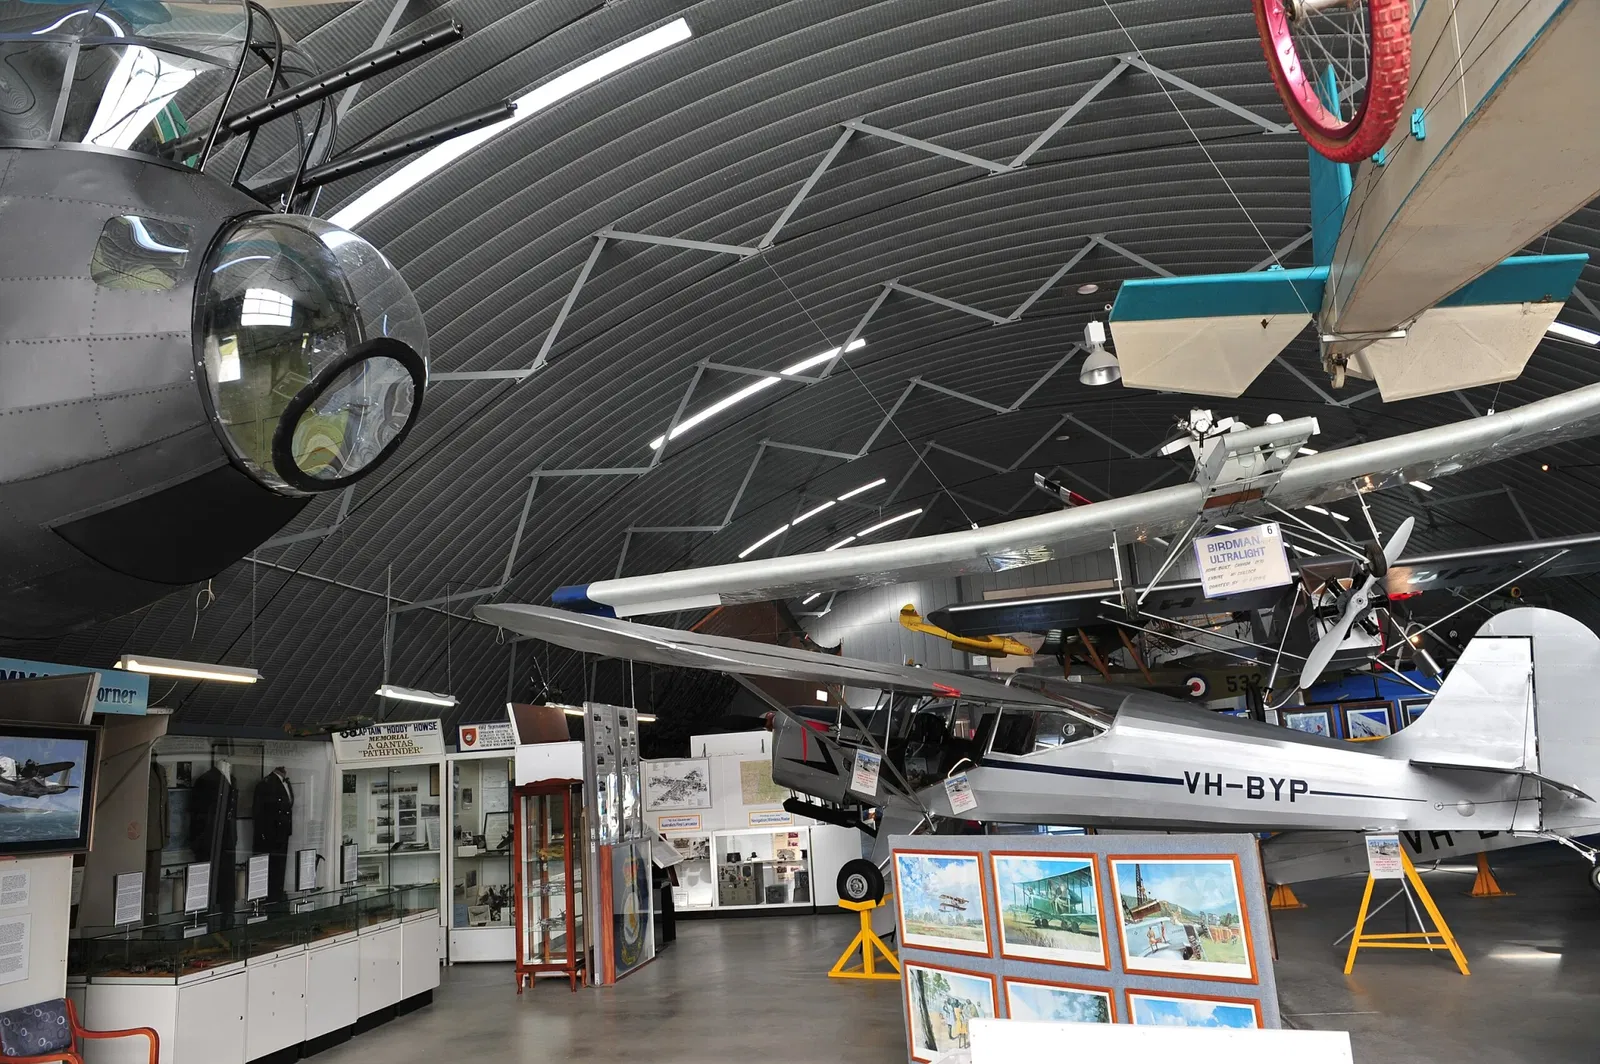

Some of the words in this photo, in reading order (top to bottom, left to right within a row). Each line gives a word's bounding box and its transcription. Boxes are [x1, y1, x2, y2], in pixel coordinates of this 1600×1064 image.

[1266, 525, 1273, 535] 6
[1207, 535, 1260, 553] BIRDMAN
[1209, 546, 1266, 565] ULTRALIGHT
[97, 687, 137, 704] orner
[413, 721, 438, 732] HOWSE
[368, 733, 410, 742] MEMORIAL
[367, 742, 374, 750] A
[375, 739, 414, 750] QANTAS
[358, 746, 424, 758] "PATHFINDER"
[1183, 771, 1308, 802] VH-BYP
